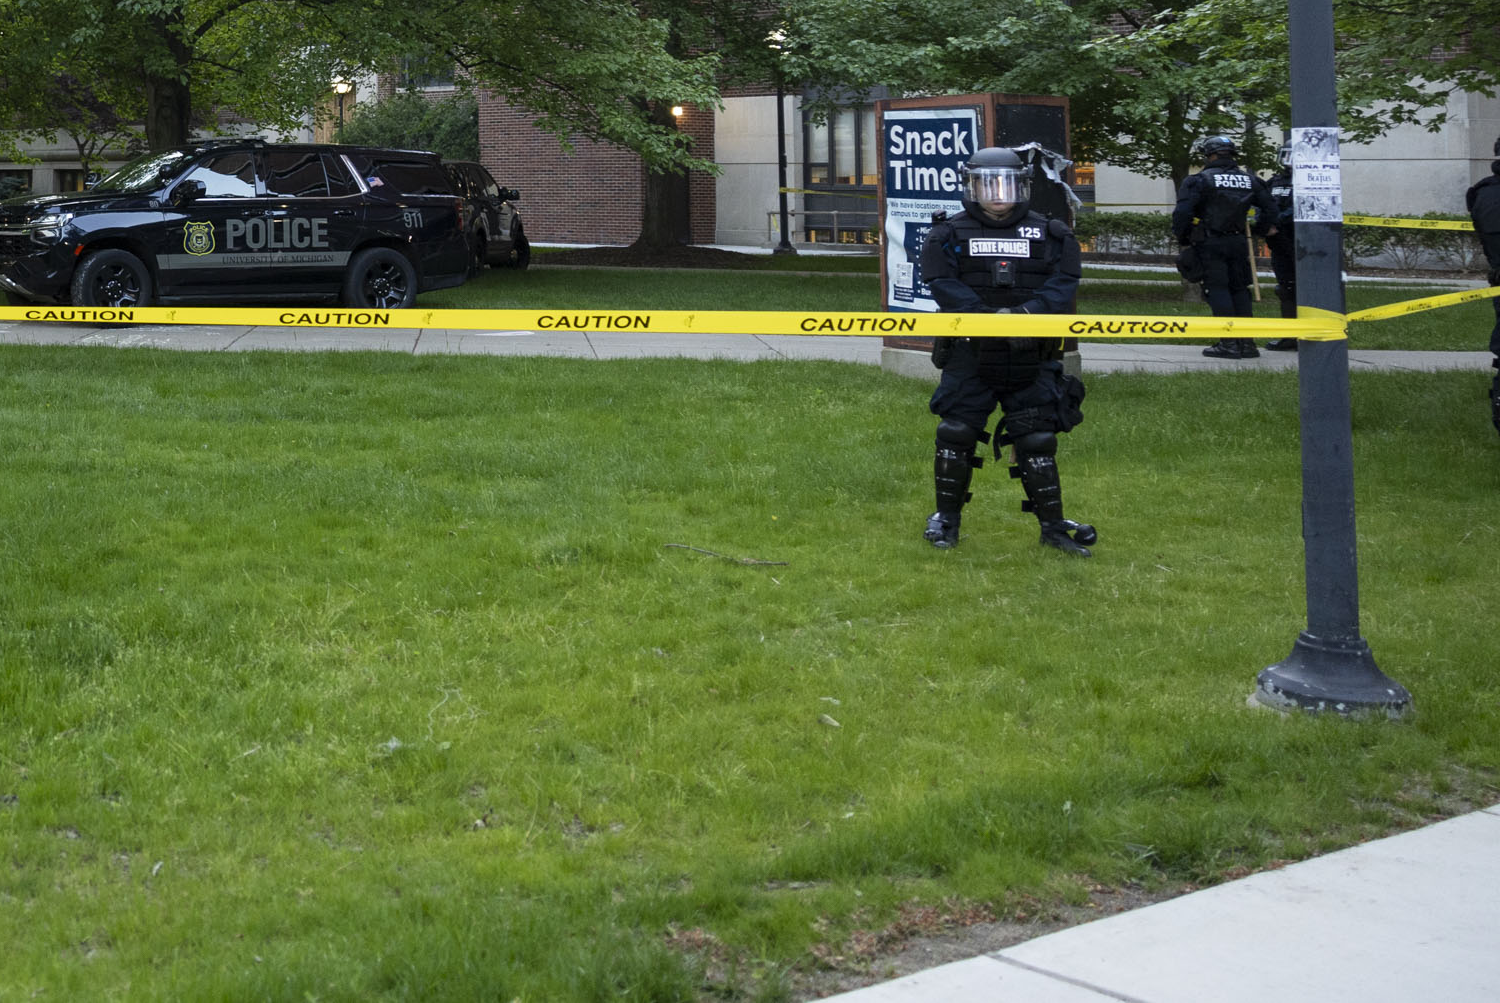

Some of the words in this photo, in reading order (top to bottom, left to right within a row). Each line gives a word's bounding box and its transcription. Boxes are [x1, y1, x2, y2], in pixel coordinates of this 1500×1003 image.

[889, 123, 970, 155] Snack
[1213, 174, 1251, 182] STATE
[1215, 180, 1252, 189] POLICE
[403, 212, 423, 229] 911
[189, 224, 209, 234] POLICE
[226, 217, 329, 249] POLICE
[1018, 226, 1041, 239] 125
[972, 241, 997, 253] STATE
[997, 241, 1028, 254] POLICE
[222, 255, 277, 265] UNIVERSITY
[277, 254, 288, 263] OF
[291, 254, 334, 264] MICHIGAN
[25, 309, 135, 321] CAUTION
[279, 312, 390, 325] CAUTION
[536, 315, 651, 329] CAUTION
[800, 317, 917, 332] CAUTION
[1068, 320, 1188, 334] CAUTION
